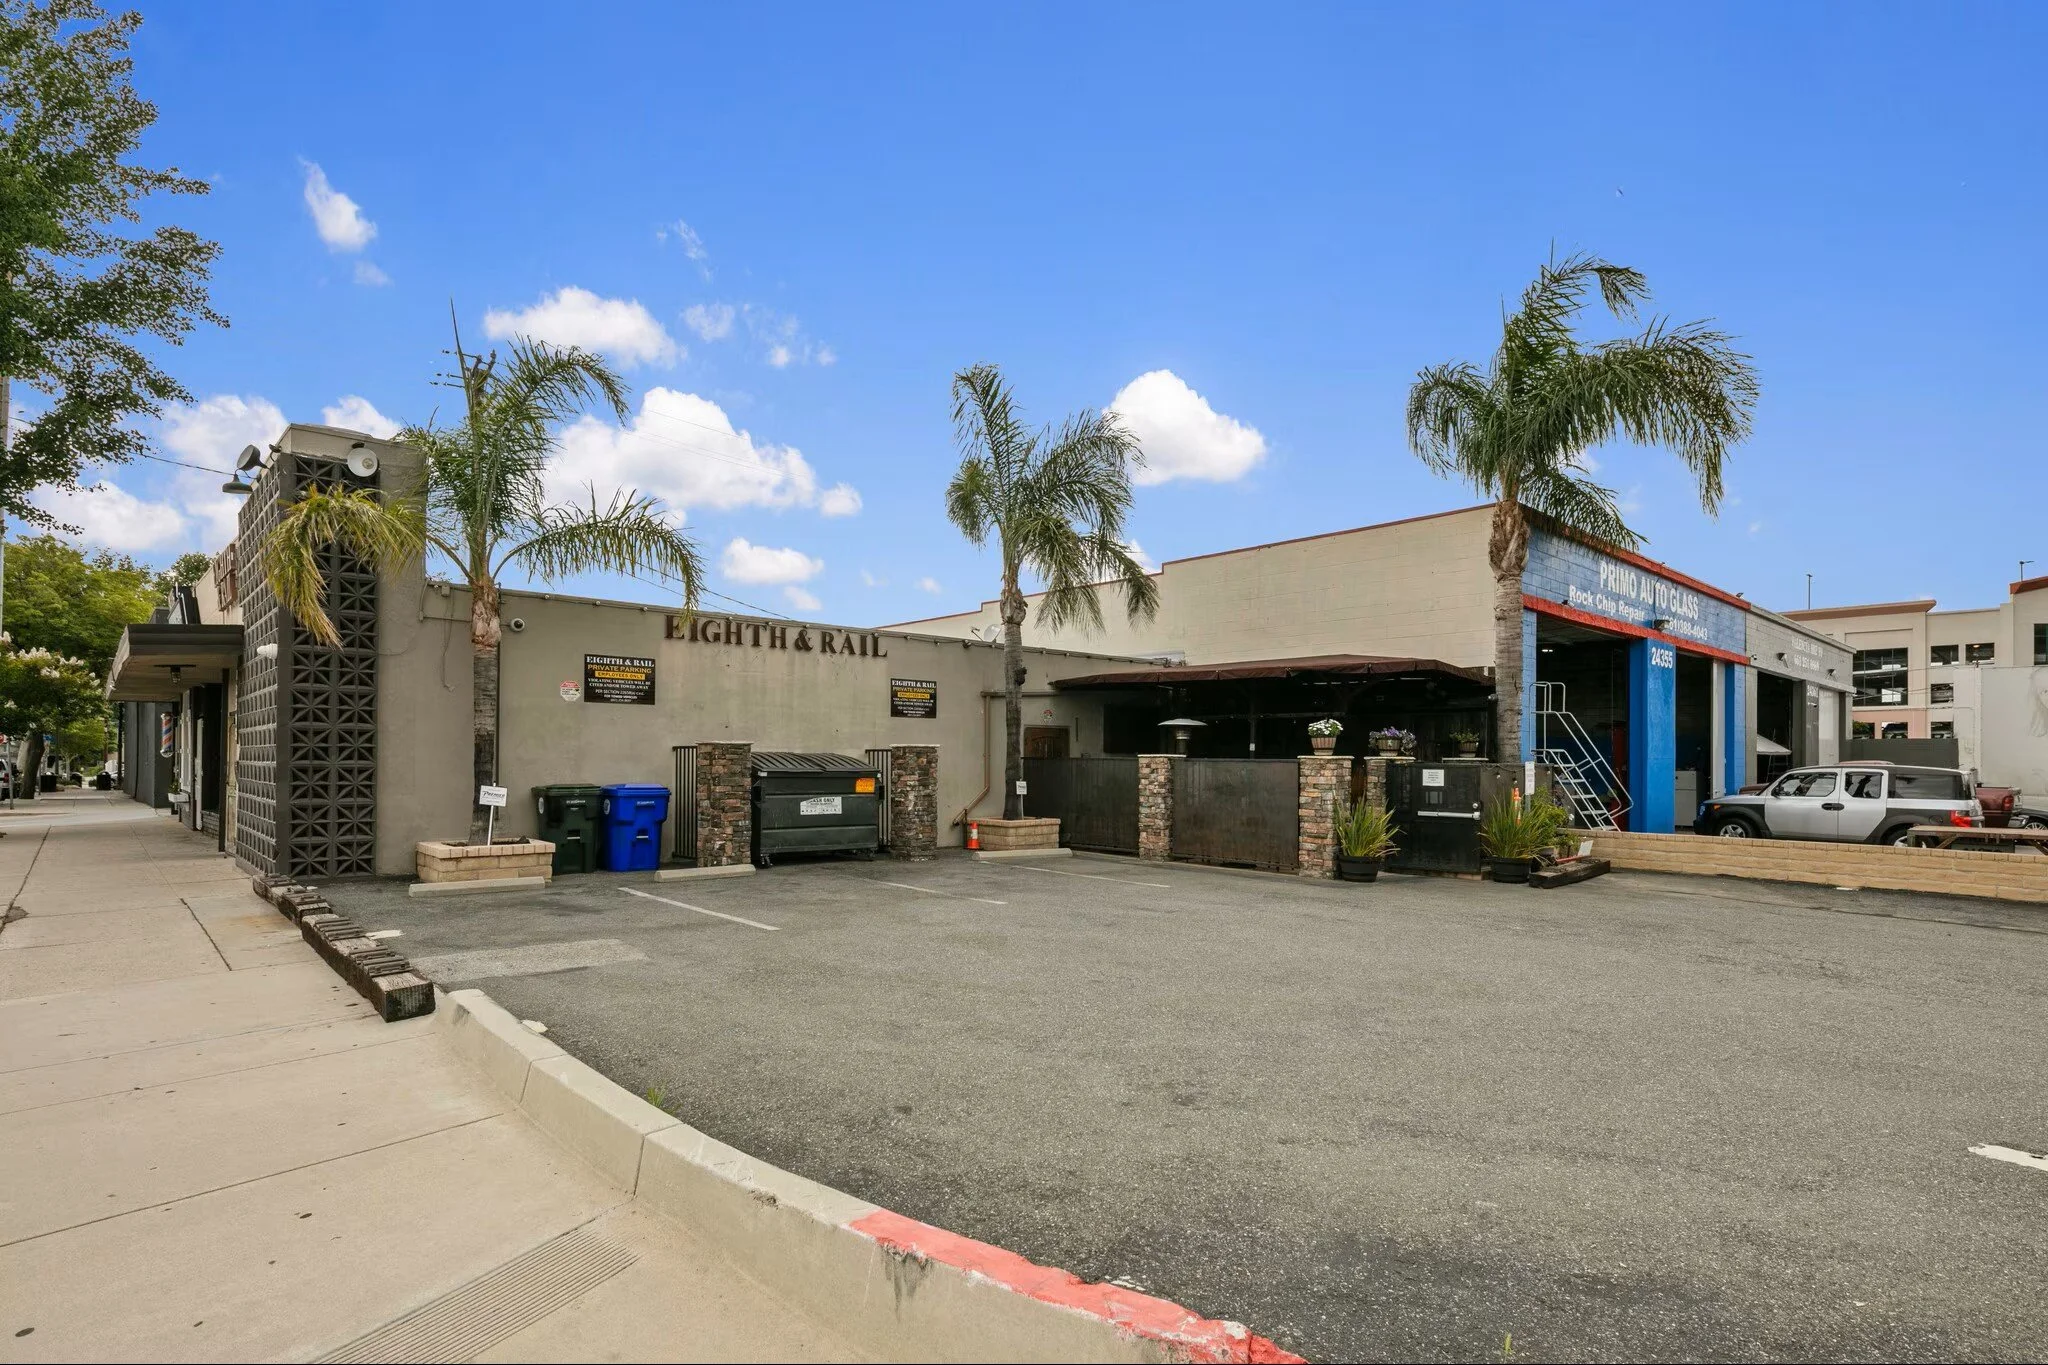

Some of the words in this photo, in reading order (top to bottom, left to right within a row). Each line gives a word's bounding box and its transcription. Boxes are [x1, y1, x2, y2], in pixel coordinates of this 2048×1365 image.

[1569, 584, 1593, 606] Rock
[1596, 593, 1616, 616] Chip
[1618, 600, 1645, 622] Repair
[1600, 560, 1637, 599] PRIMO
[1640, 576, 1667, 610] AUTO
[1669, 588, 1699, 620] GLASS
[664, 614, 788, 650] EIGHTH
[794, 627, 814, 651] &
[820, 631, 888, 657] RAIL
[586, 656, 623, 665] EIGHTH
[1651, 647, 1673, 669] 24355
